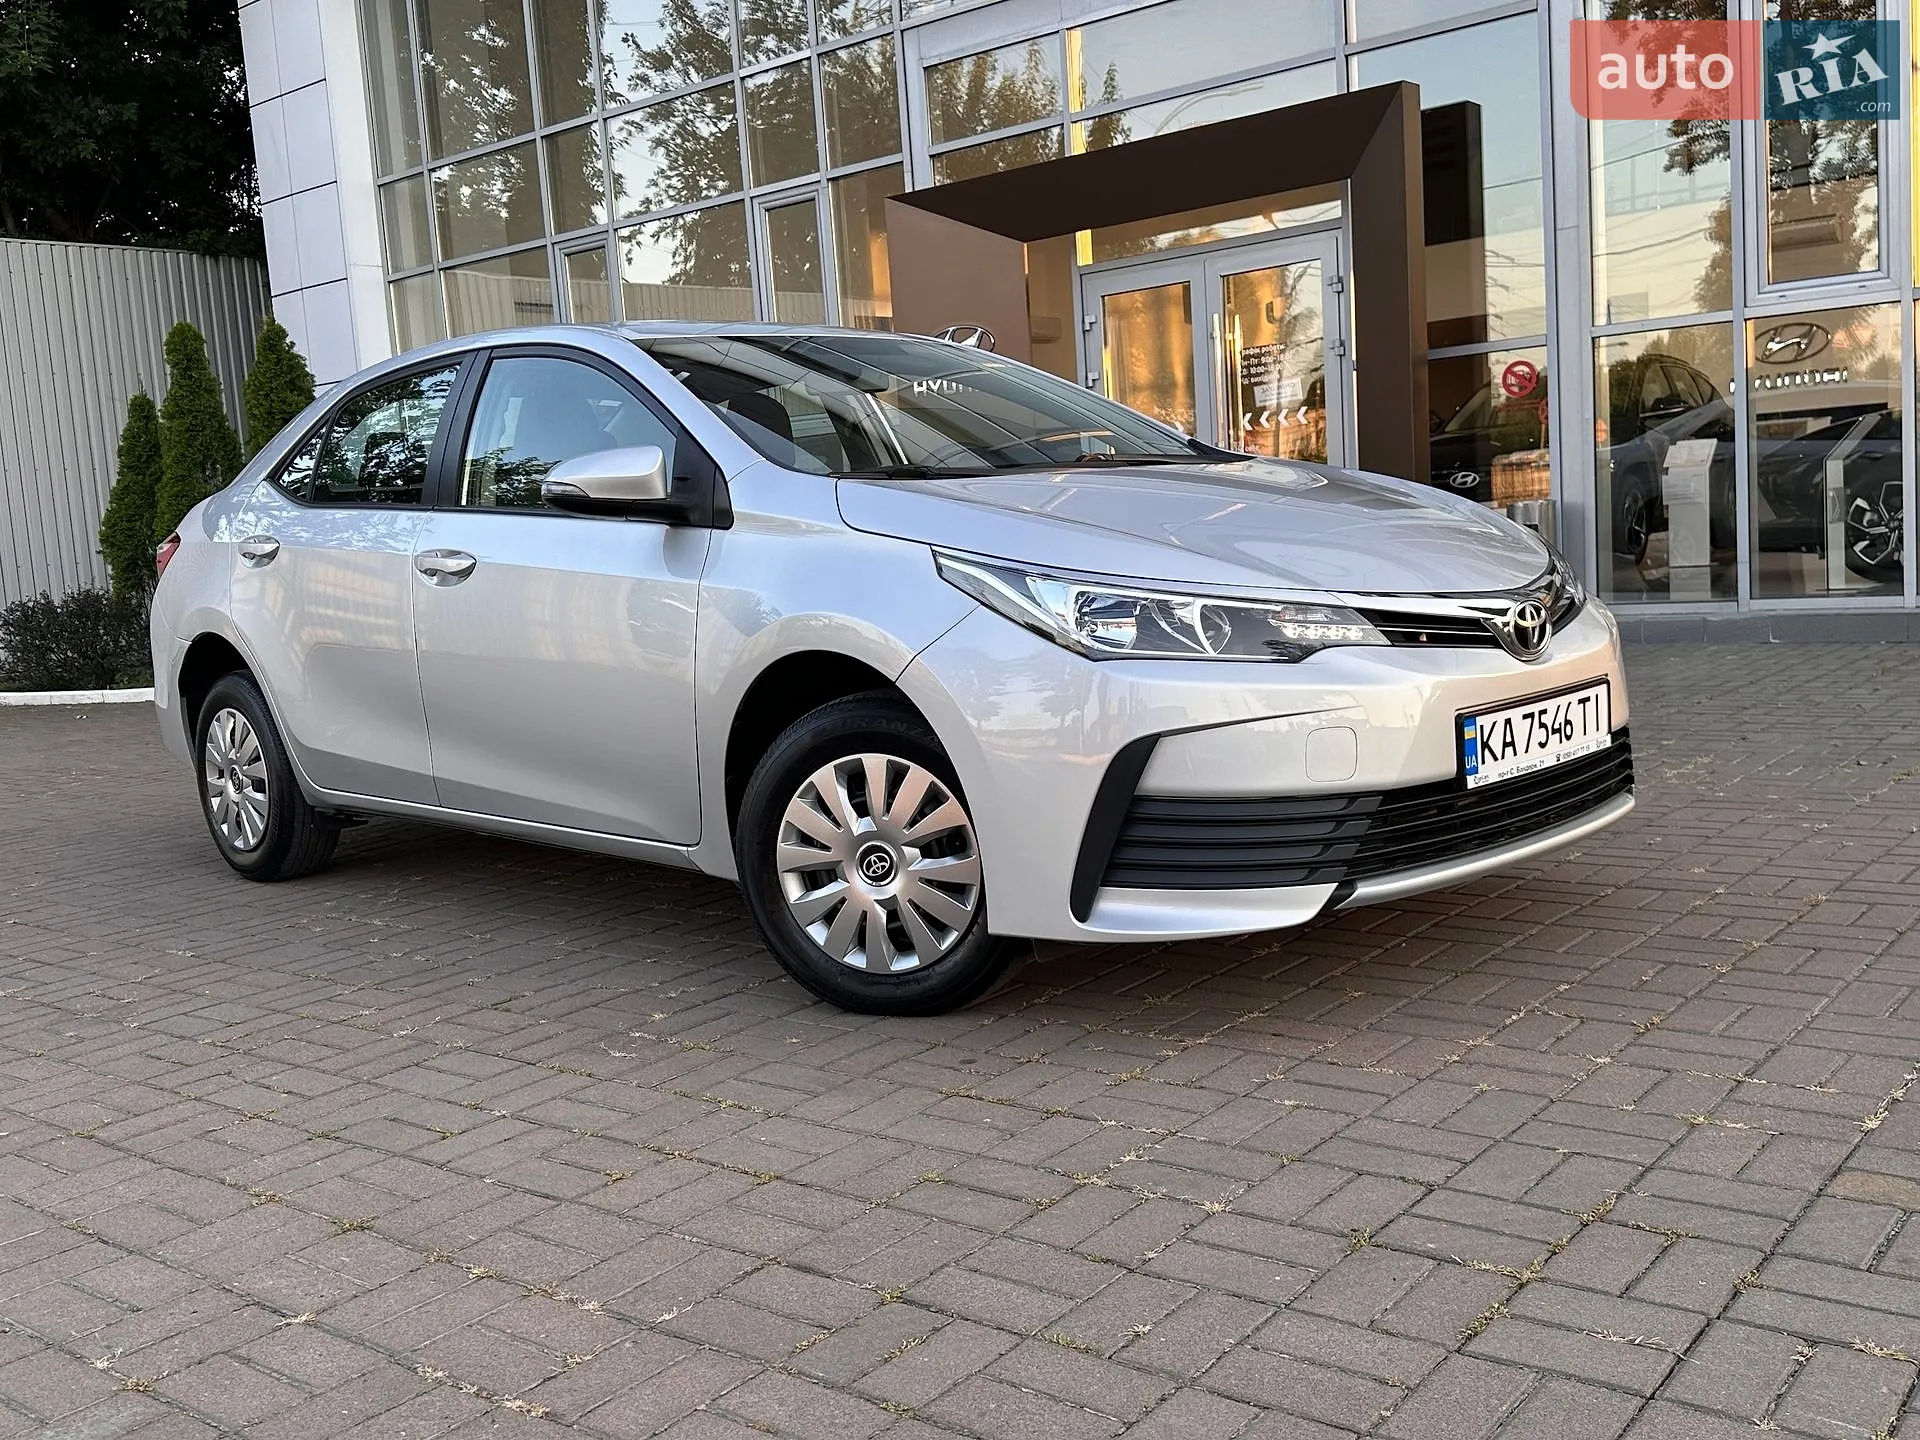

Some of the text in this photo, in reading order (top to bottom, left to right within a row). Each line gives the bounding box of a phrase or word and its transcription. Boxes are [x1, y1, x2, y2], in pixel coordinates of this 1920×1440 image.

[1241, 347, 1261, 357] рафік
[1480, 717, 1518, 766] KA
[1522, 701, 1574, 754] 7546
[1465, 755, 1479, 769] UA
